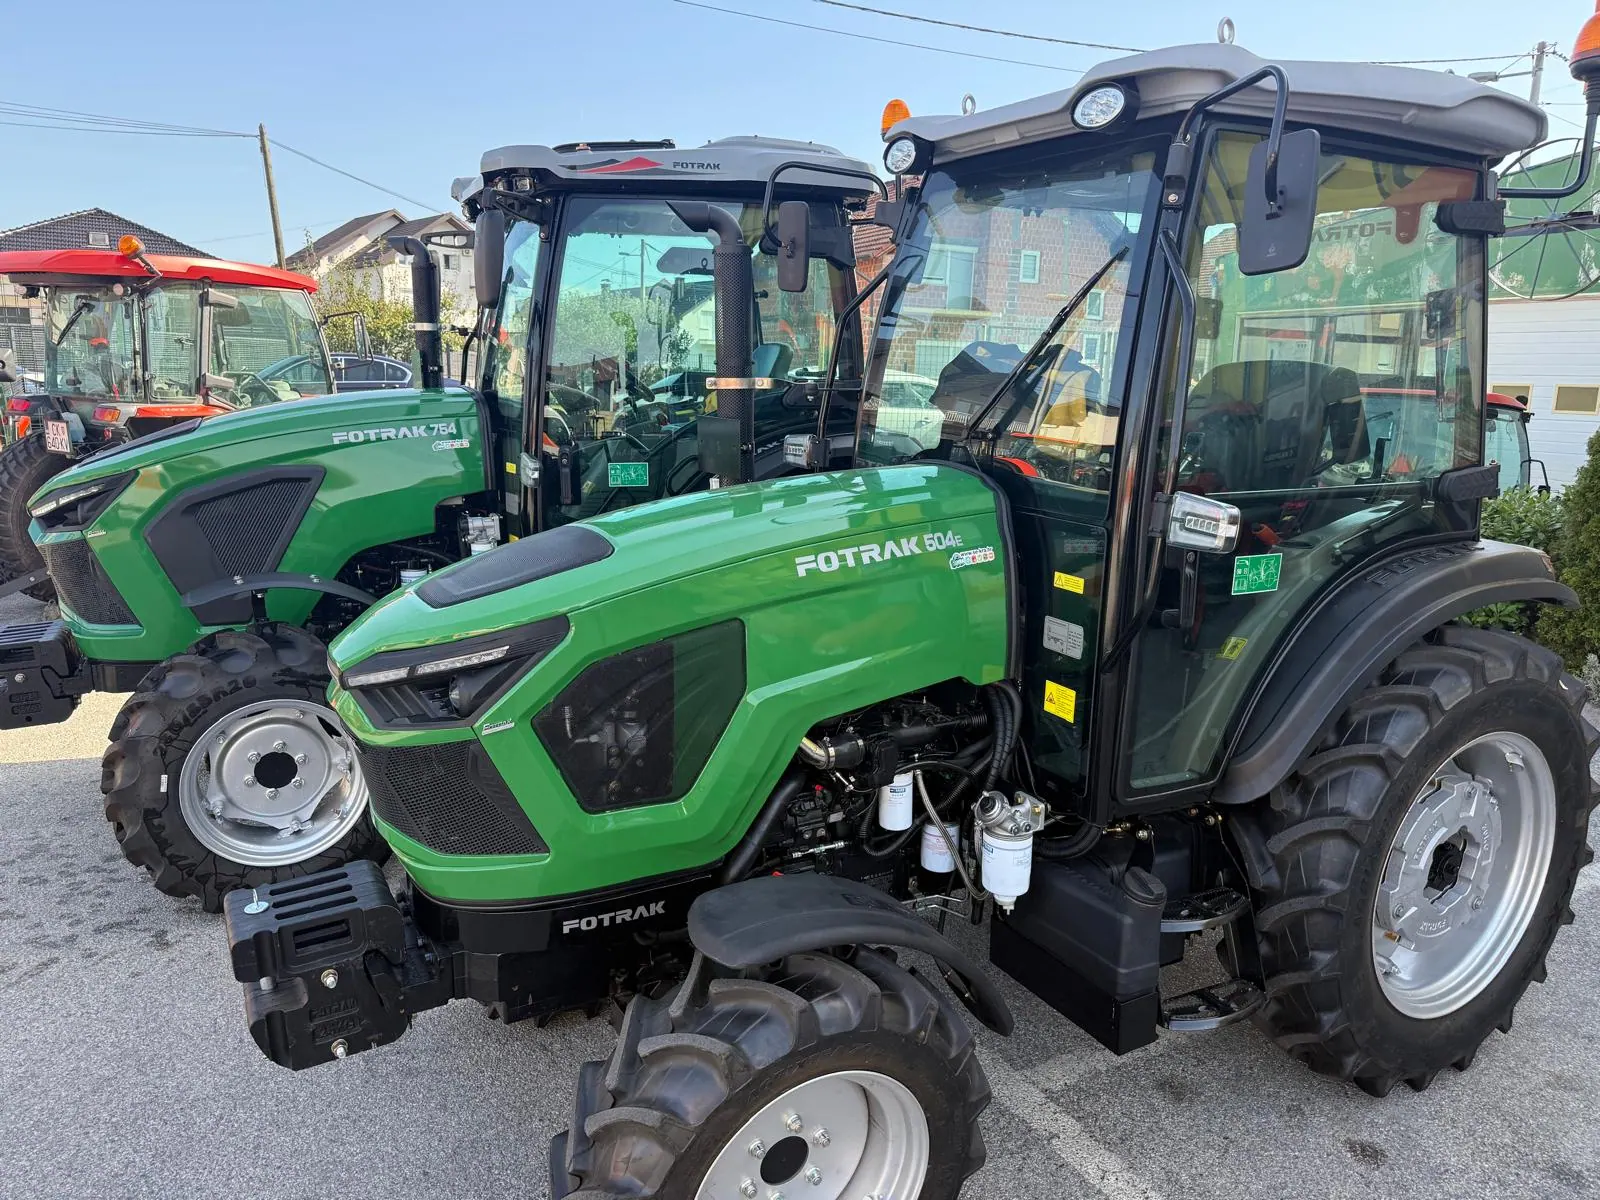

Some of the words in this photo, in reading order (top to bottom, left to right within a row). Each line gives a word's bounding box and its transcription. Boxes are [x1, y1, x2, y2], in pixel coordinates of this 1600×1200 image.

[672, 161, 721, 170] FOTRAK
[331, 424, 428, 445] FOTRAK
[429, 422, 457, 436] 754
[795, 535, 922, 577] FOTRAK
[563, 900, 666, 934] FOTRAK
